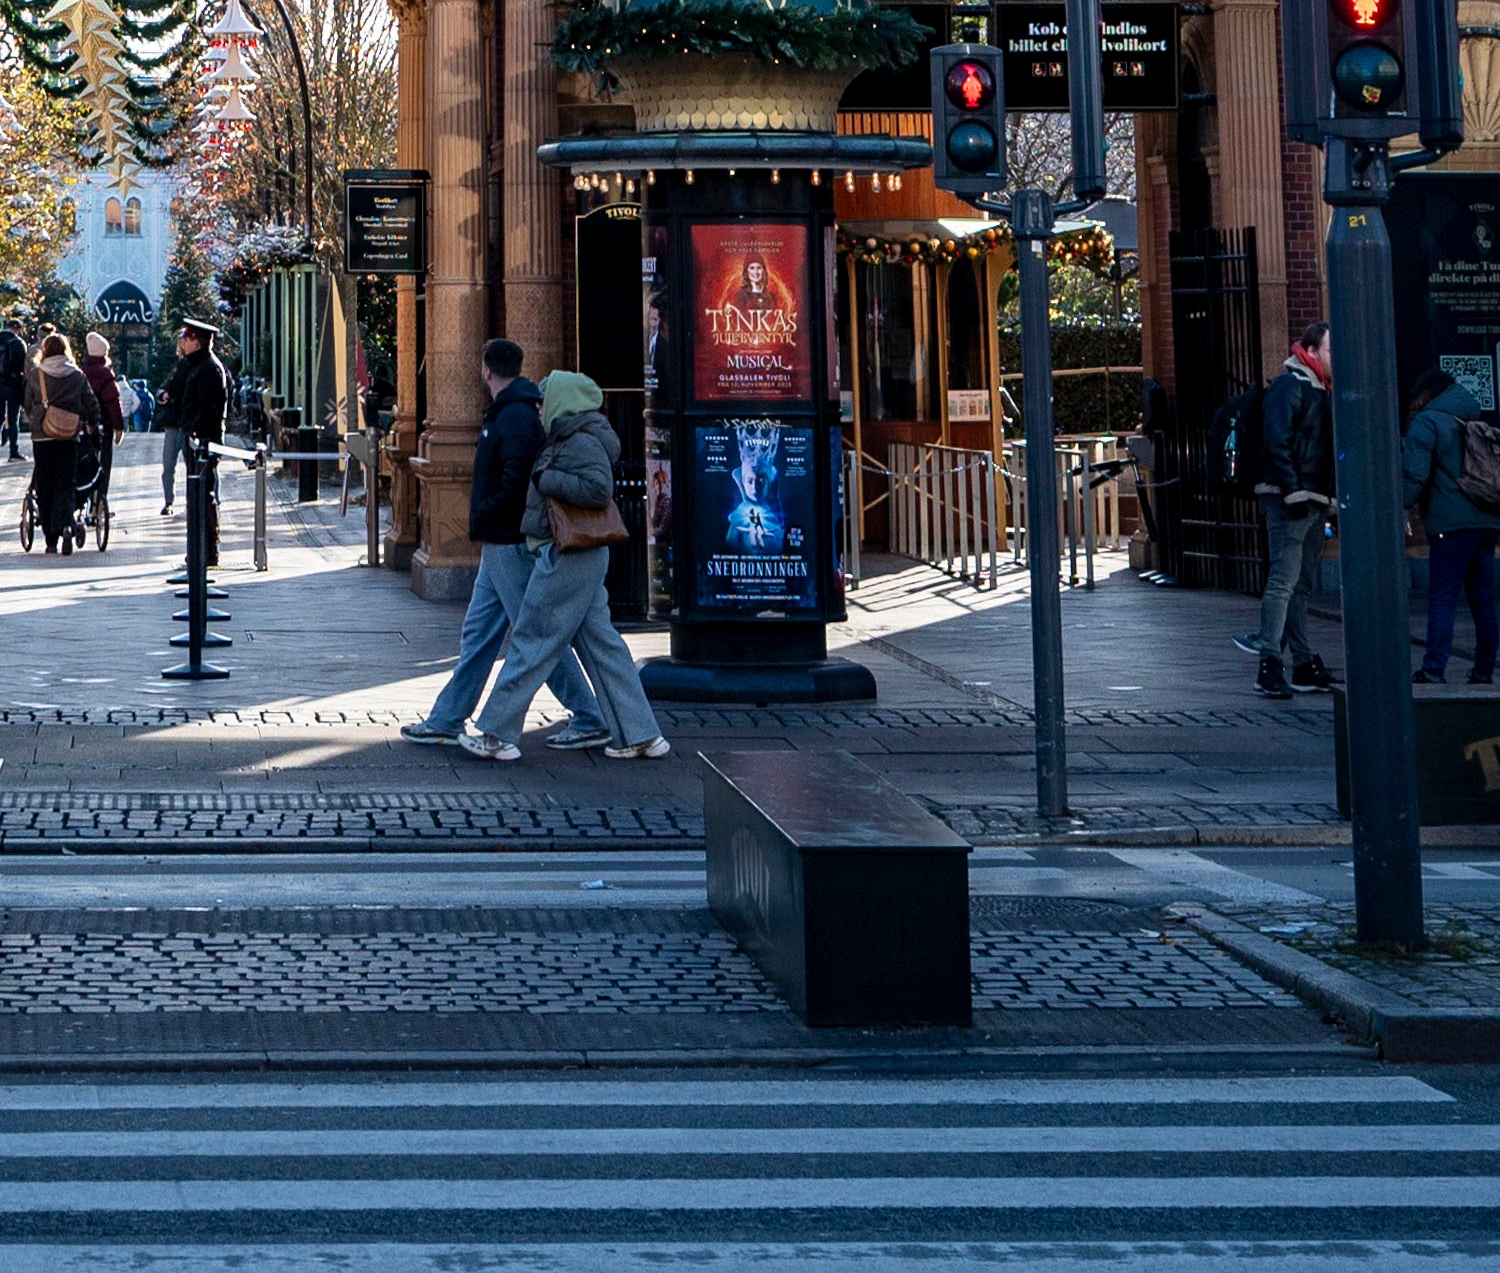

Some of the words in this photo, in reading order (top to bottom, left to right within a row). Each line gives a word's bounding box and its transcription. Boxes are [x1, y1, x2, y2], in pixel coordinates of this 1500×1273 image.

[1009, 39, 1049, 52] billet
[1102, 39, 1167, 52] ivolikort
[1348, 214, 1367, 227] 21
[1454, 260, 1479, 271] dine
[1428, 272, 1471, 283] direkte
[1472, 272, 1487, 285] på
[727, 355, 792, 371] MUSICAL
[707, 560, 808, 576] SNEDRONNINGEN
